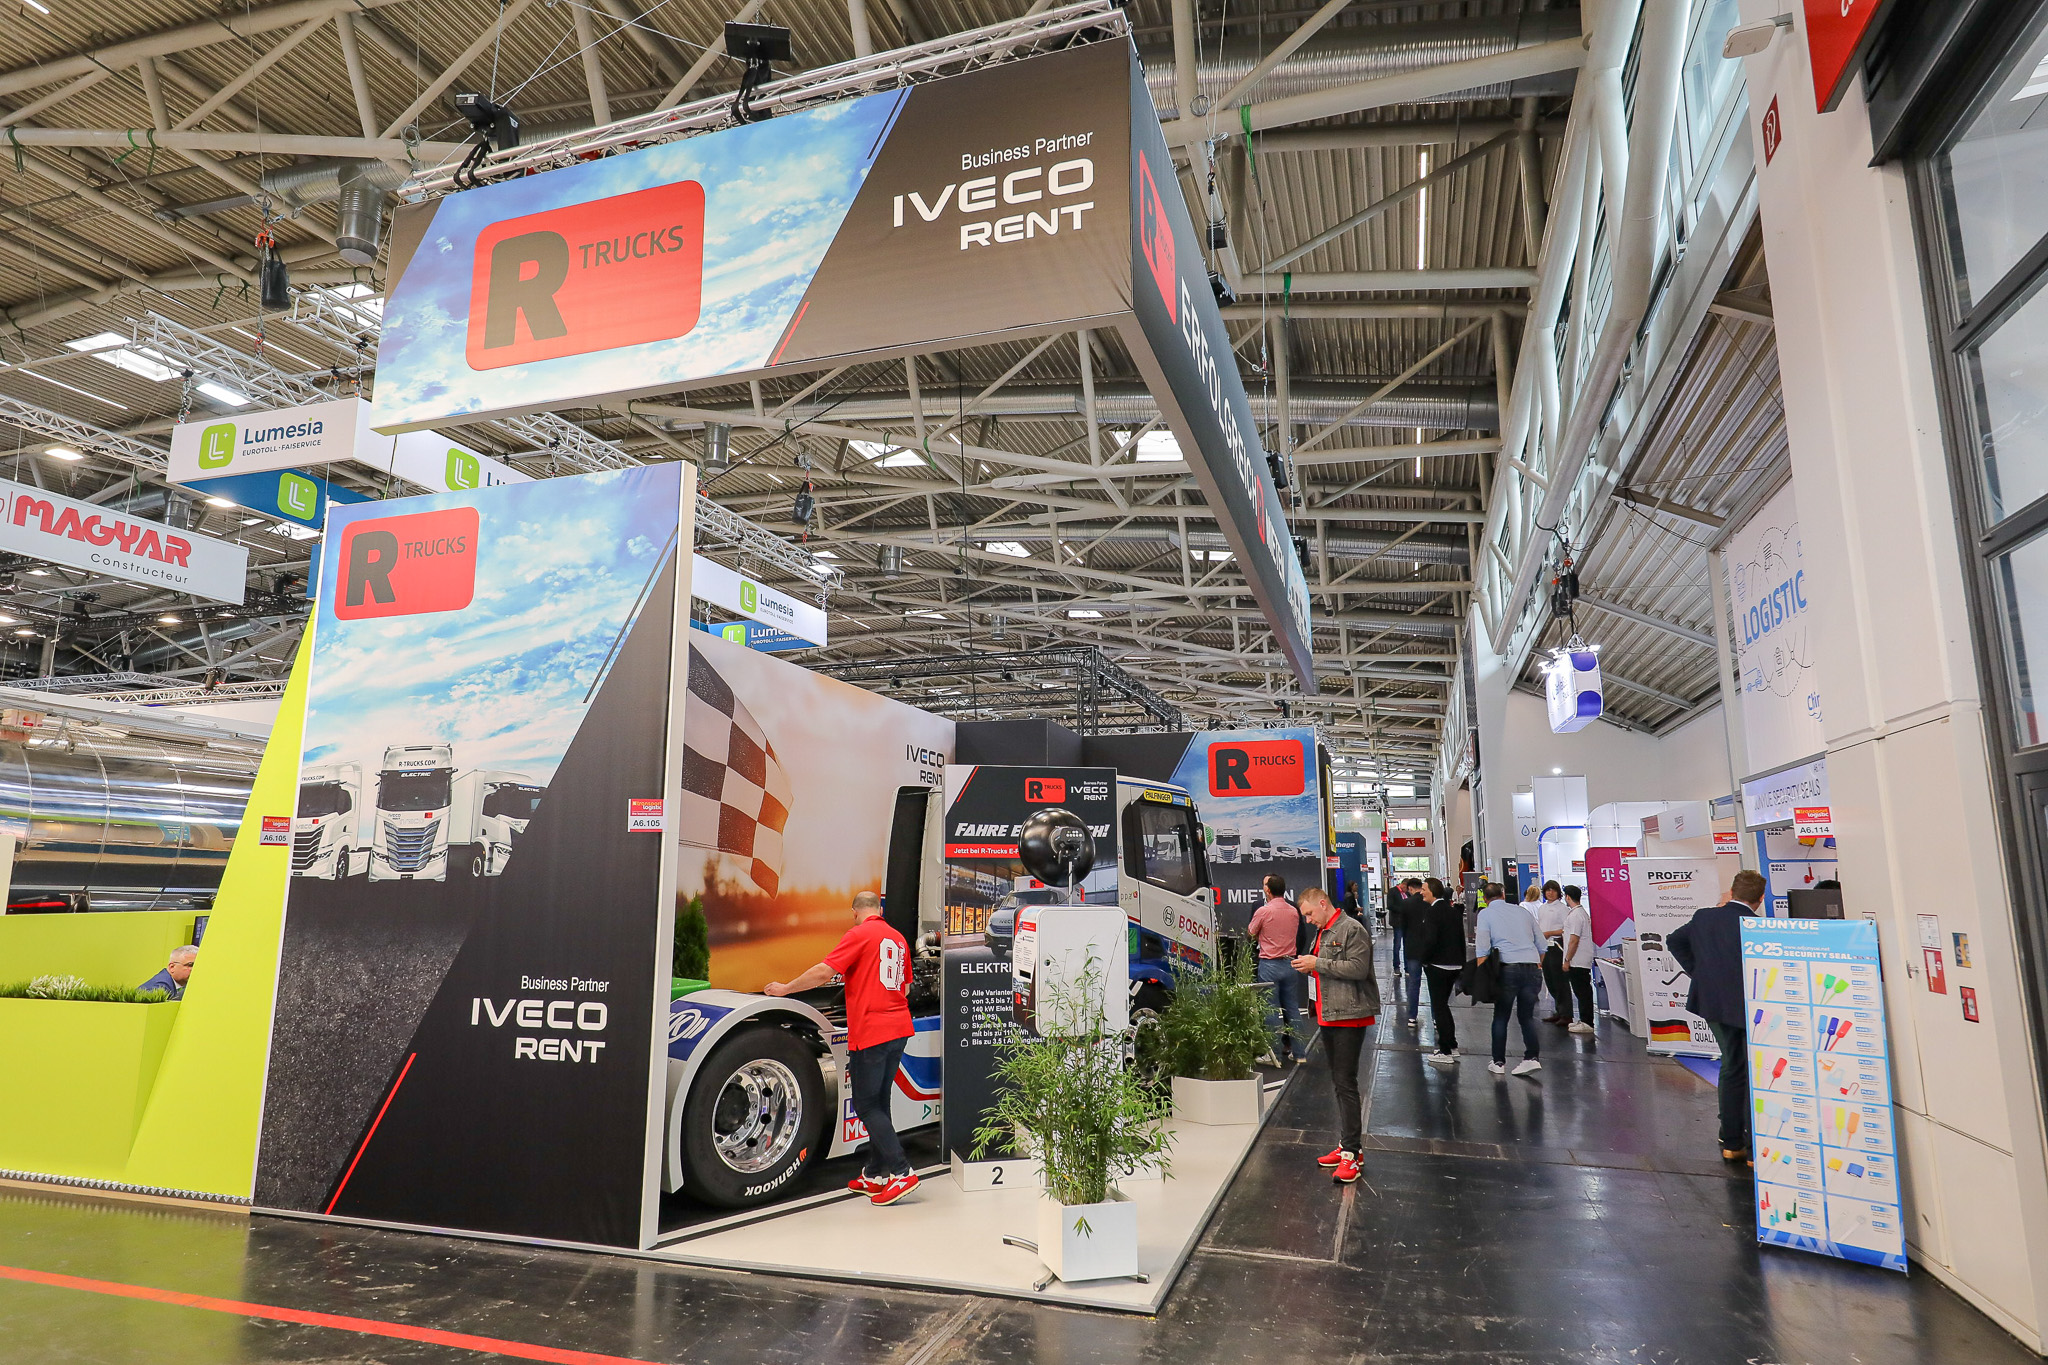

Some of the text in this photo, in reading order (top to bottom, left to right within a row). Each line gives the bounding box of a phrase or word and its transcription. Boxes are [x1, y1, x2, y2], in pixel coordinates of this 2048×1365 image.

[961, 131, 1093, 172] Business Partner
[893, 157, 1094, 228] IVECO
[960, 201, 1095, 250] RENT
[483, 225, 684, 349] R TRUCKS
[1181, 275, 1258, 517] ERFOLGREICH
[243, 417, 324, 445] Lumesia
[13, 494, 192, 568] MAGYAR
[91, 552, 188, 585] Constructeur
[345, 530, 466, 607] R TRUCKS
[760, 593, 794, 618] Lumesia
[1743, 569, 1807, 646] LOGISTIC
[398, 759, 437, 767] R-TRUCKS.COM
[906, 744, 945, 769] IVECO
[1215, 748, 1296, 790] R TRUCKS
[1029, 781, 1044, 800] R
[1070, 786, 1108, 794] IVECO
[633, 819, 661, 827] A6.105
[954, 822, 1010, 837] FAHRE
[1799, 826, 1830, 834] A6.114
[263, 834, 287, 842] A6.105
[981, 847, 1008, 855] R-Trucks
[1657, 883, 1691, 891] Germany
[1178, 915, 1209, 940] BOSCH
[1758, 919, 1819, 931] JUNYUE
[1783, 950, 1828, 959] SECURITY
[1828, 952, 1853, 960] SEAL
[521, 975, 610, 993] Business Partner
[471, 997, 608, 1031] IVECO
[515, 1036, 606, 1064] RENT
[991, 1166, 1004, 1186] 2
